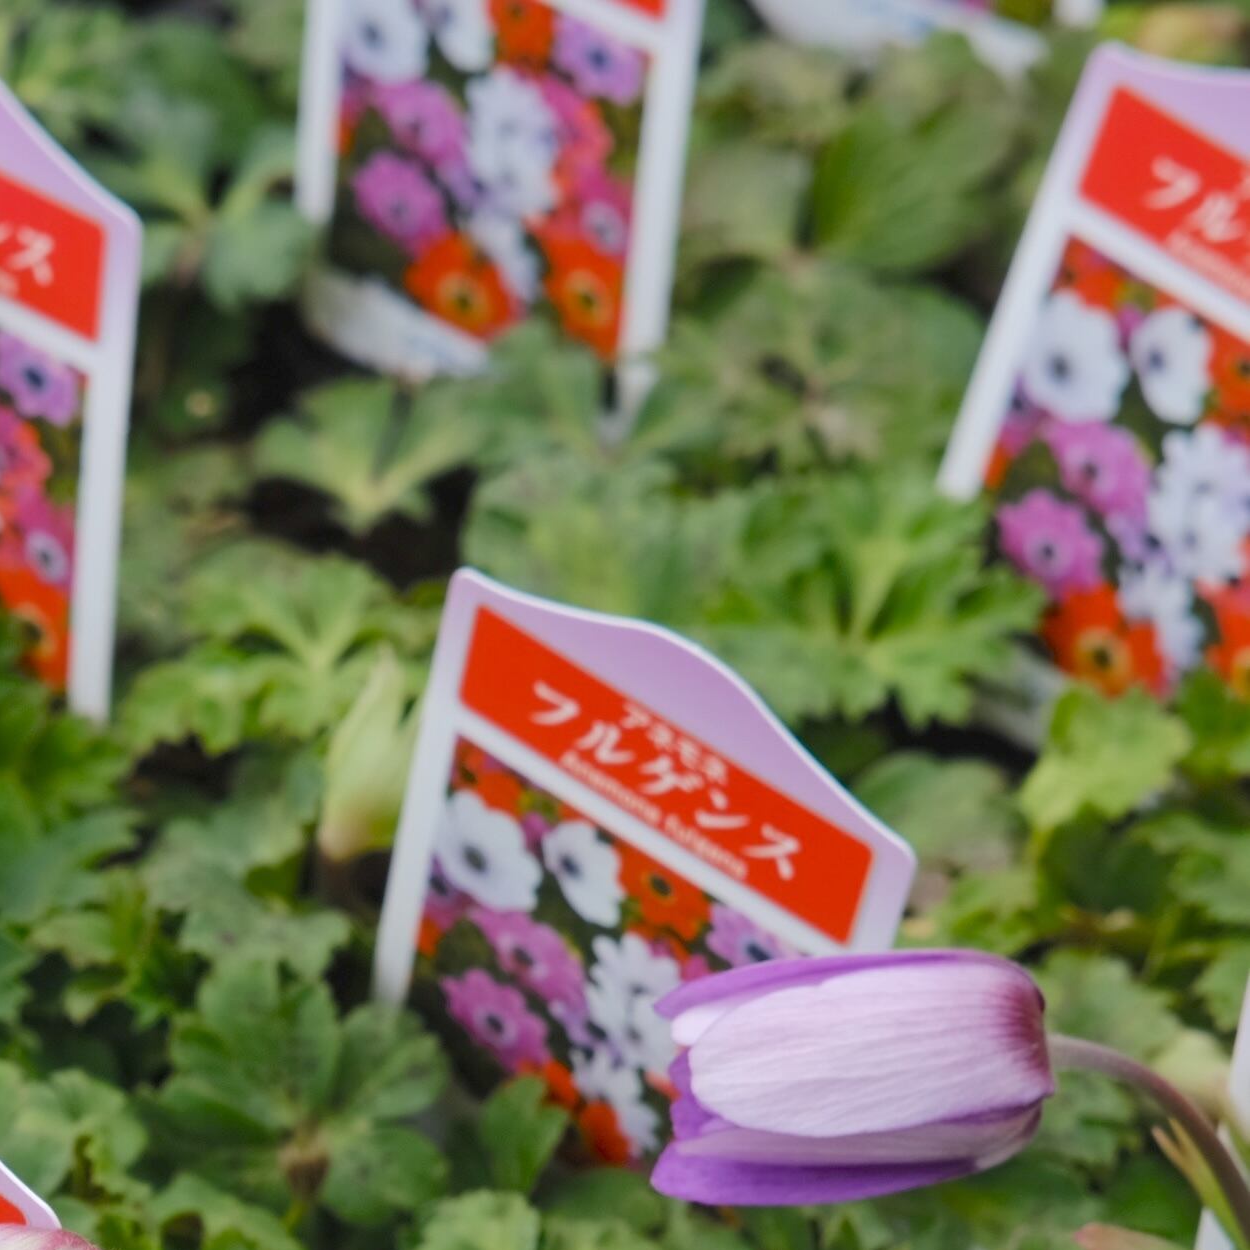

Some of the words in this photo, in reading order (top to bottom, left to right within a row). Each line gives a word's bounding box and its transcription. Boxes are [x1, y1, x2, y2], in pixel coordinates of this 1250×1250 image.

[529, 680, 800, 880] フルゲンス
